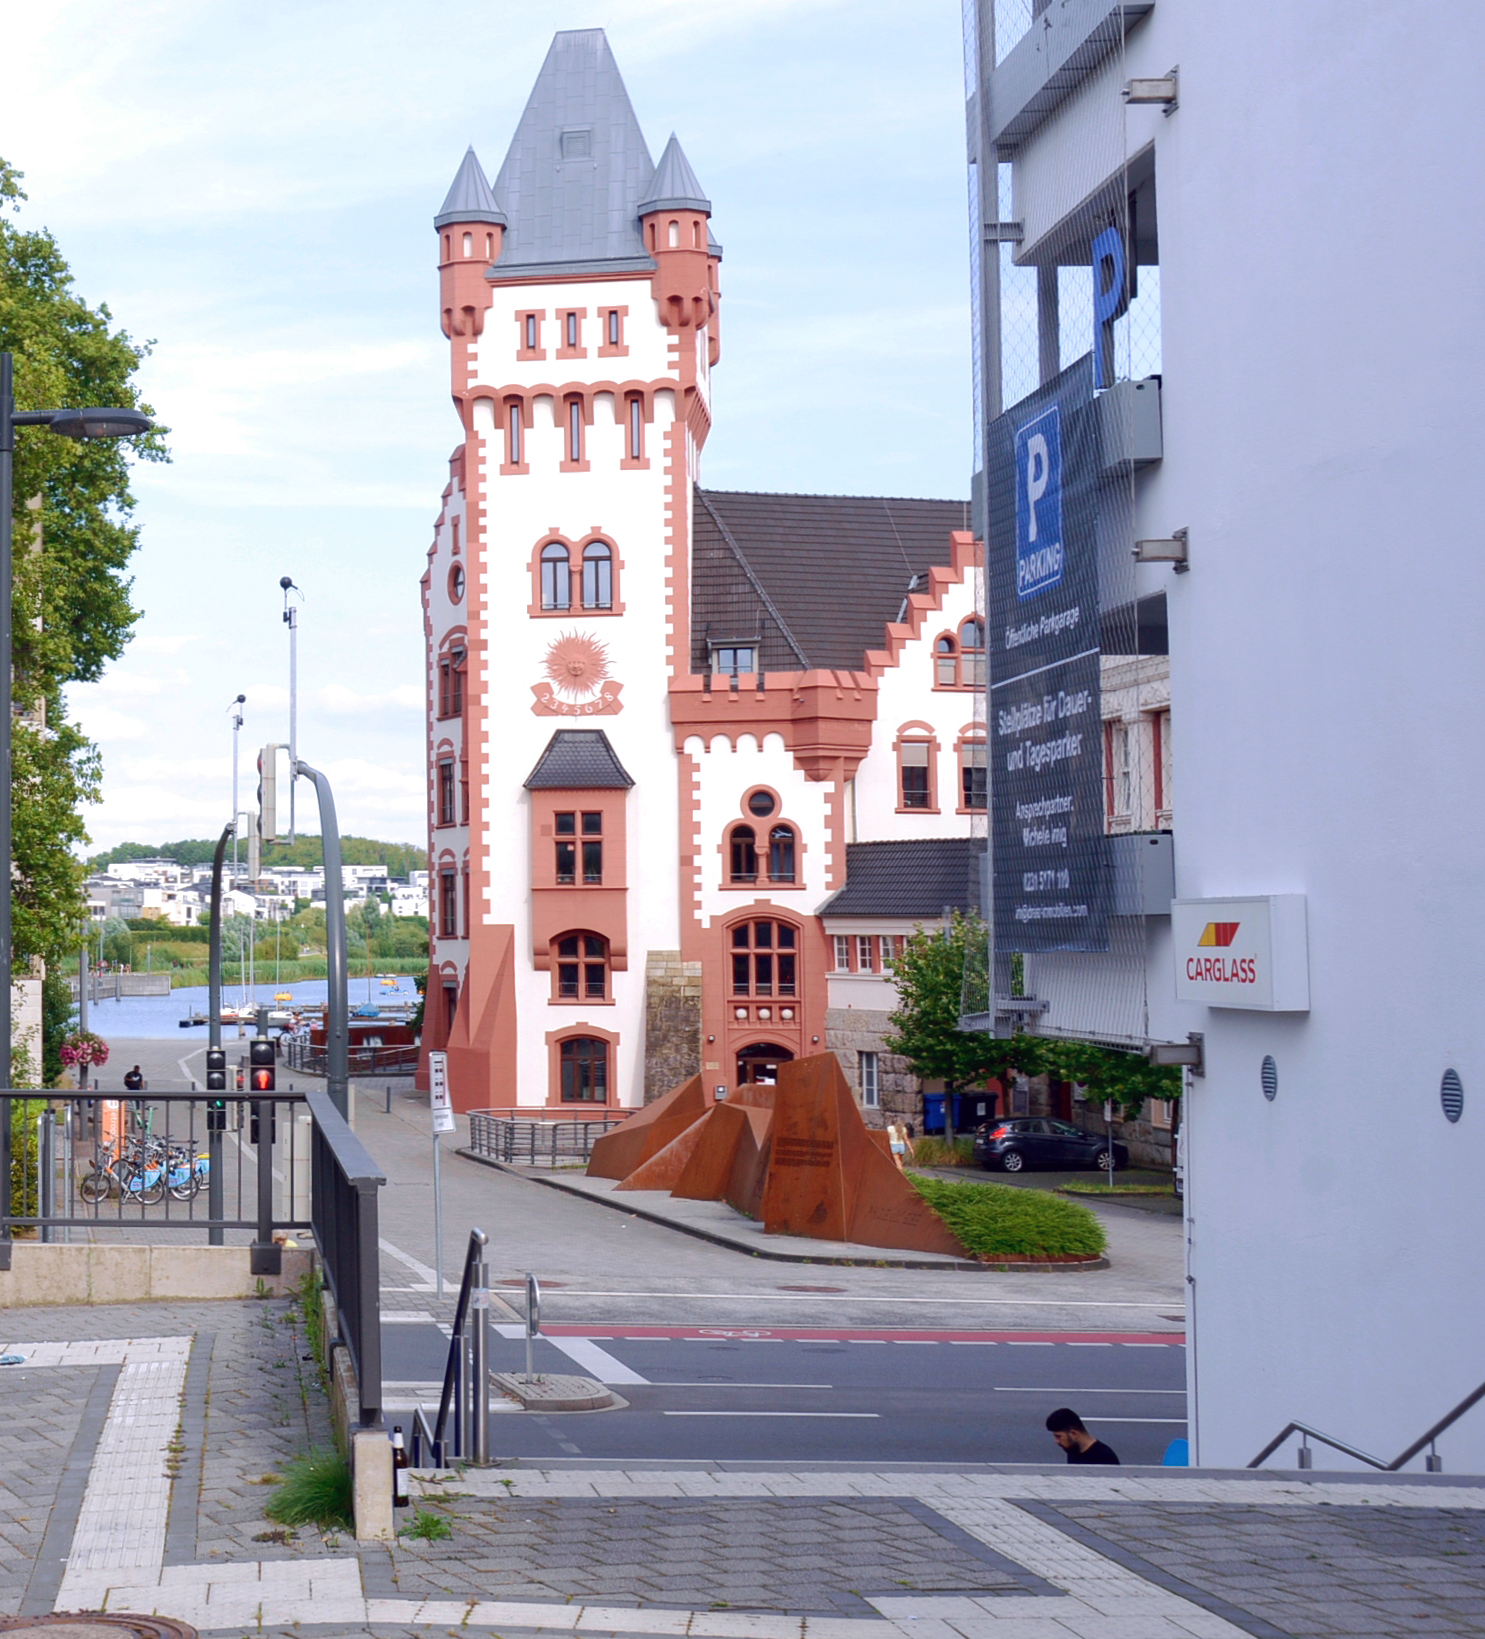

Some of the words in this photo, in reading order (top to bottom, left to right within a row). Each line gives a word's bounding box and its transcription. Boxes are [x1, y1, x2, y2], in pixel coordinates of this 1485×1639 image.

[1092, 227, 1124, 389] P
[1027, 433, 1048, 542] P
[1019, 542, 1060, 586] PARKING
[1040, 606, 1080, 636] Parkgarage
[541, 692, 550, 703] 2
[550, 700, 558, 709] 3
[562, 704, 568, 713] 4
[574, 706, 581, 714] 5
[585, 704, 593, 713] 6
[595, 700, 602, 708] 7
[604, 692, 614, 701] 8
[998, 702, 1042, 738] Stellplätze
[1043, 695, 1056, 723] für
[1058, 690, 1092, 718] Dauer-
[1007, 742, 1023, 771] und
[1025, 730, 1082, 772] Tagesparker
[1186, 958, 1256, 984] CARGLASS
